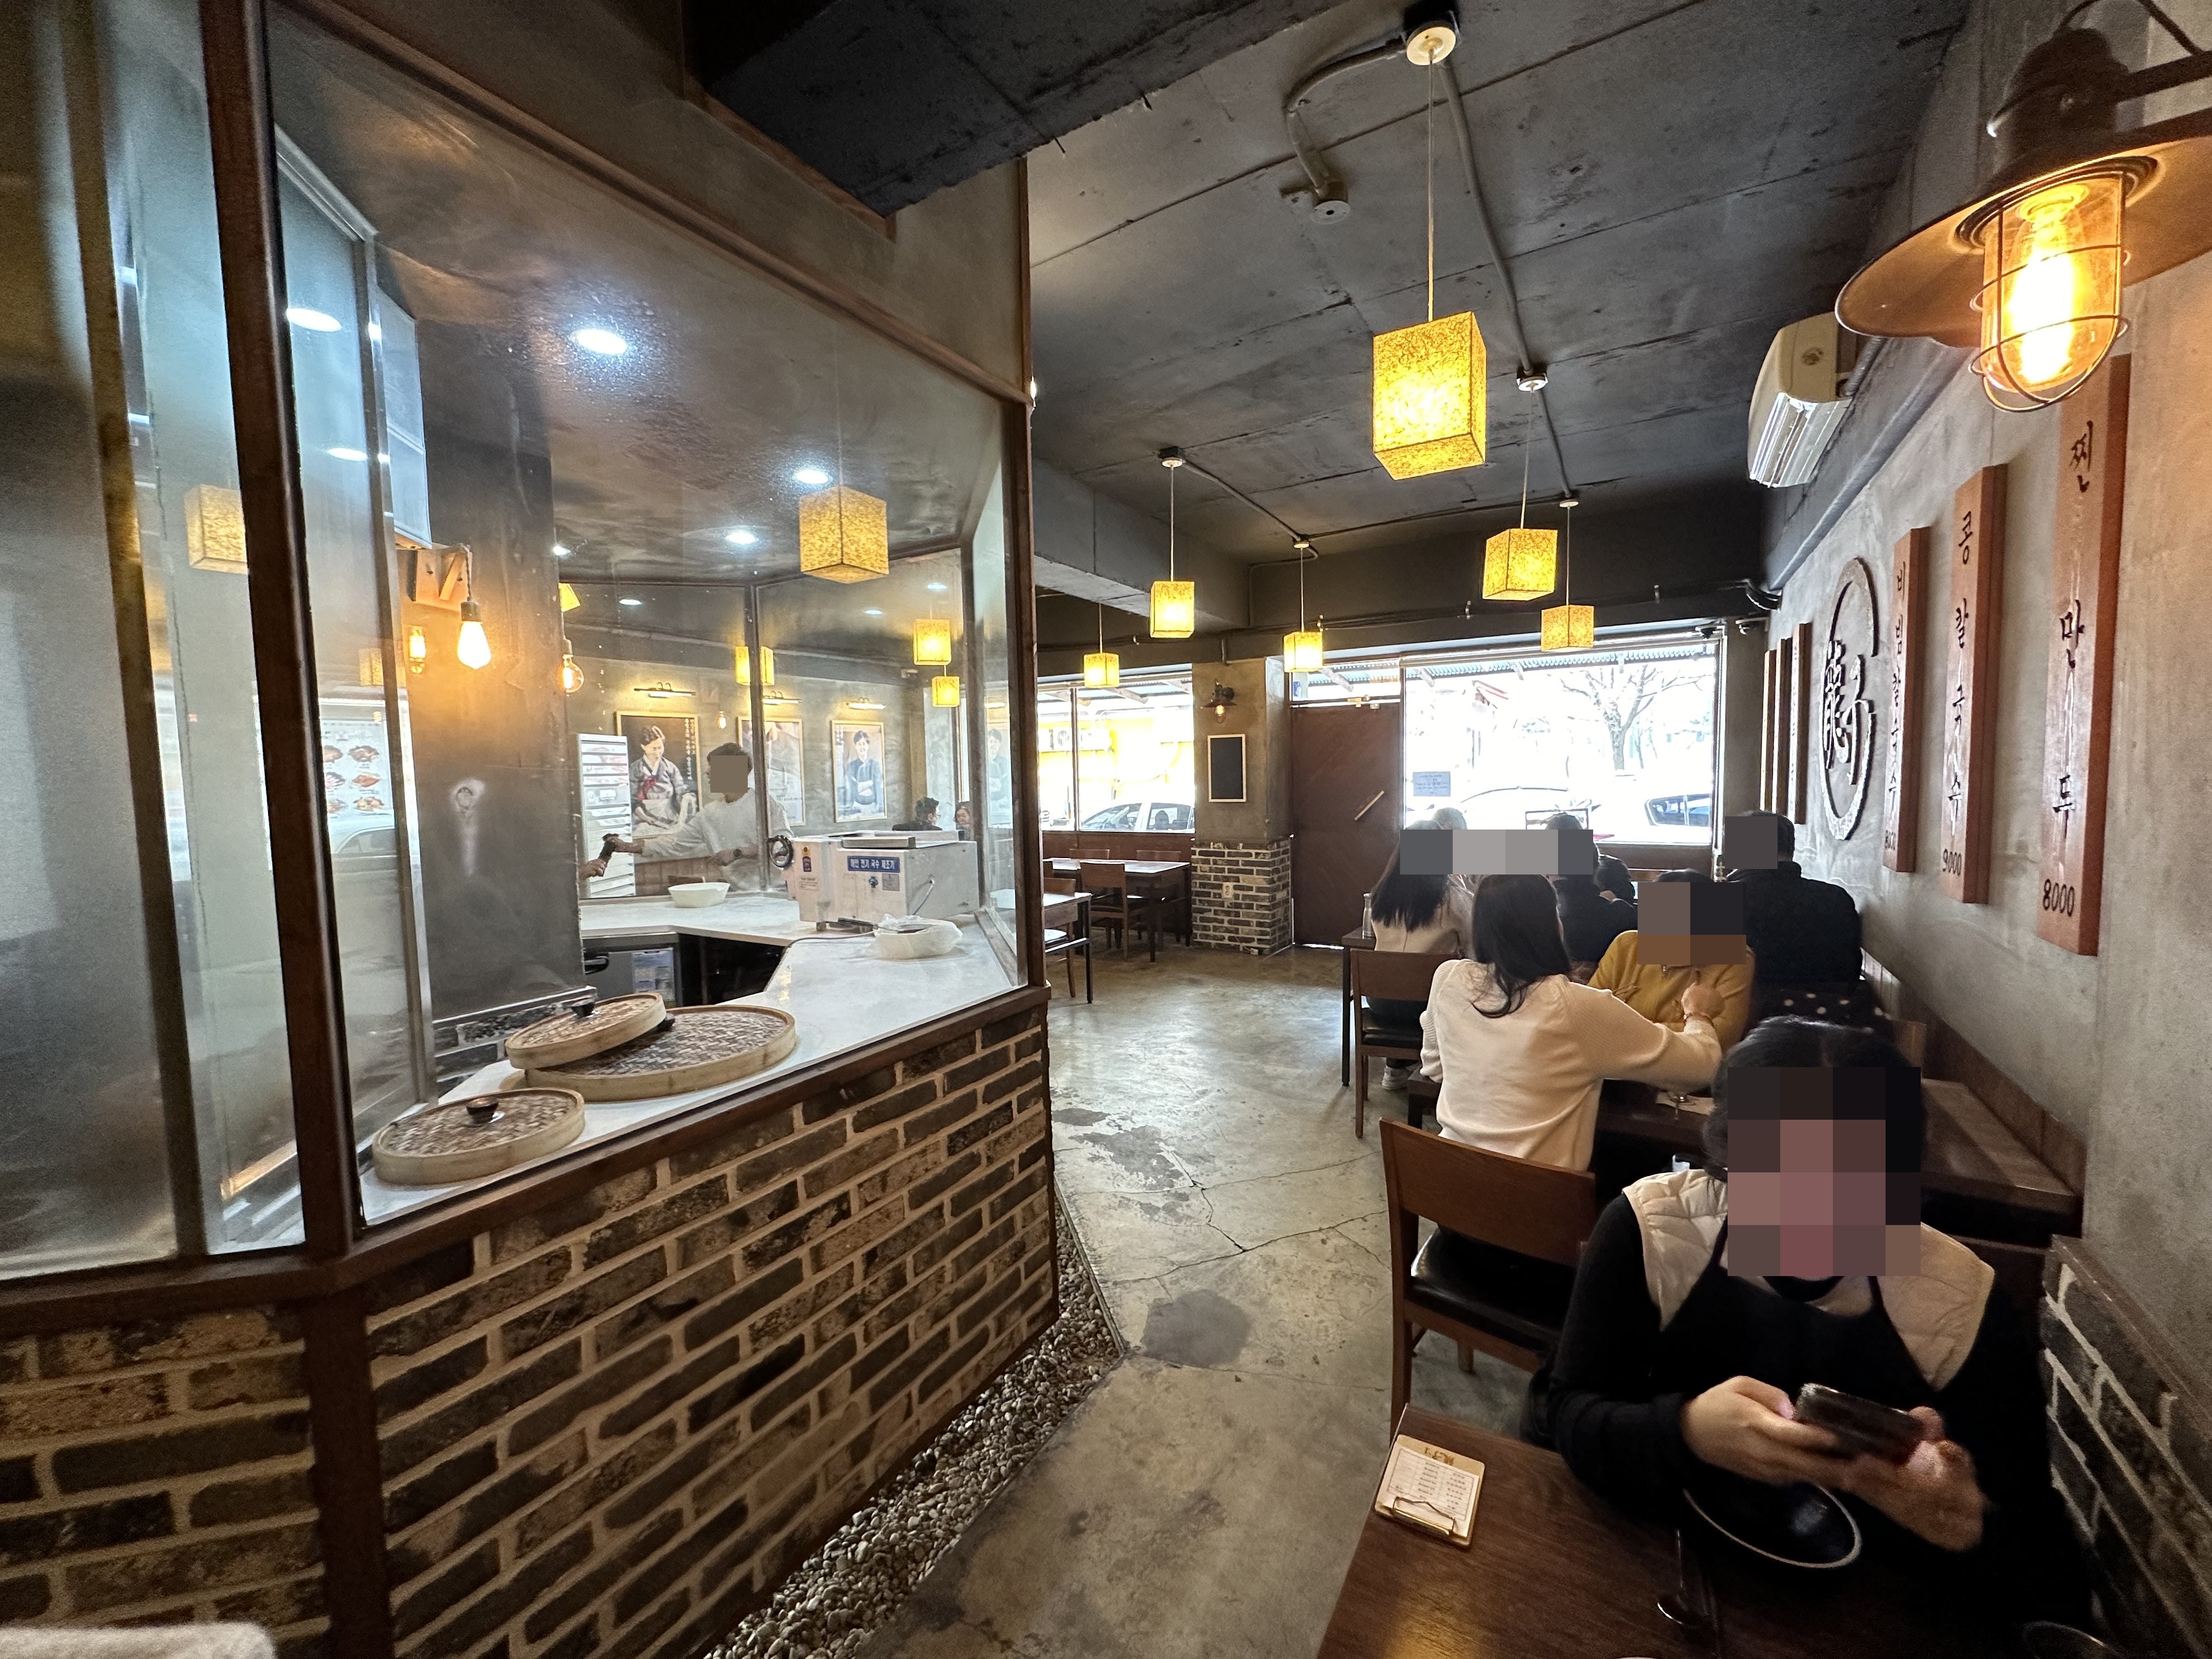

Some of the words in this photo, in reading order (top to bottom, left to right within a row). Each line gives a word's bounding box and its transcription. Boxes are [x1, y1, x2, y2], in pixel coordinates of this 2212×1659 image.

[1888, 561, 1906, 815] 비빔칼국수
[1948, 511, 1973, 826] 콩칼국수
[2052, 420, 2094, 840] 찐만두
[1943, 848, 1962, 877] 9000
[2042, 878, 2075, 917] 8000
